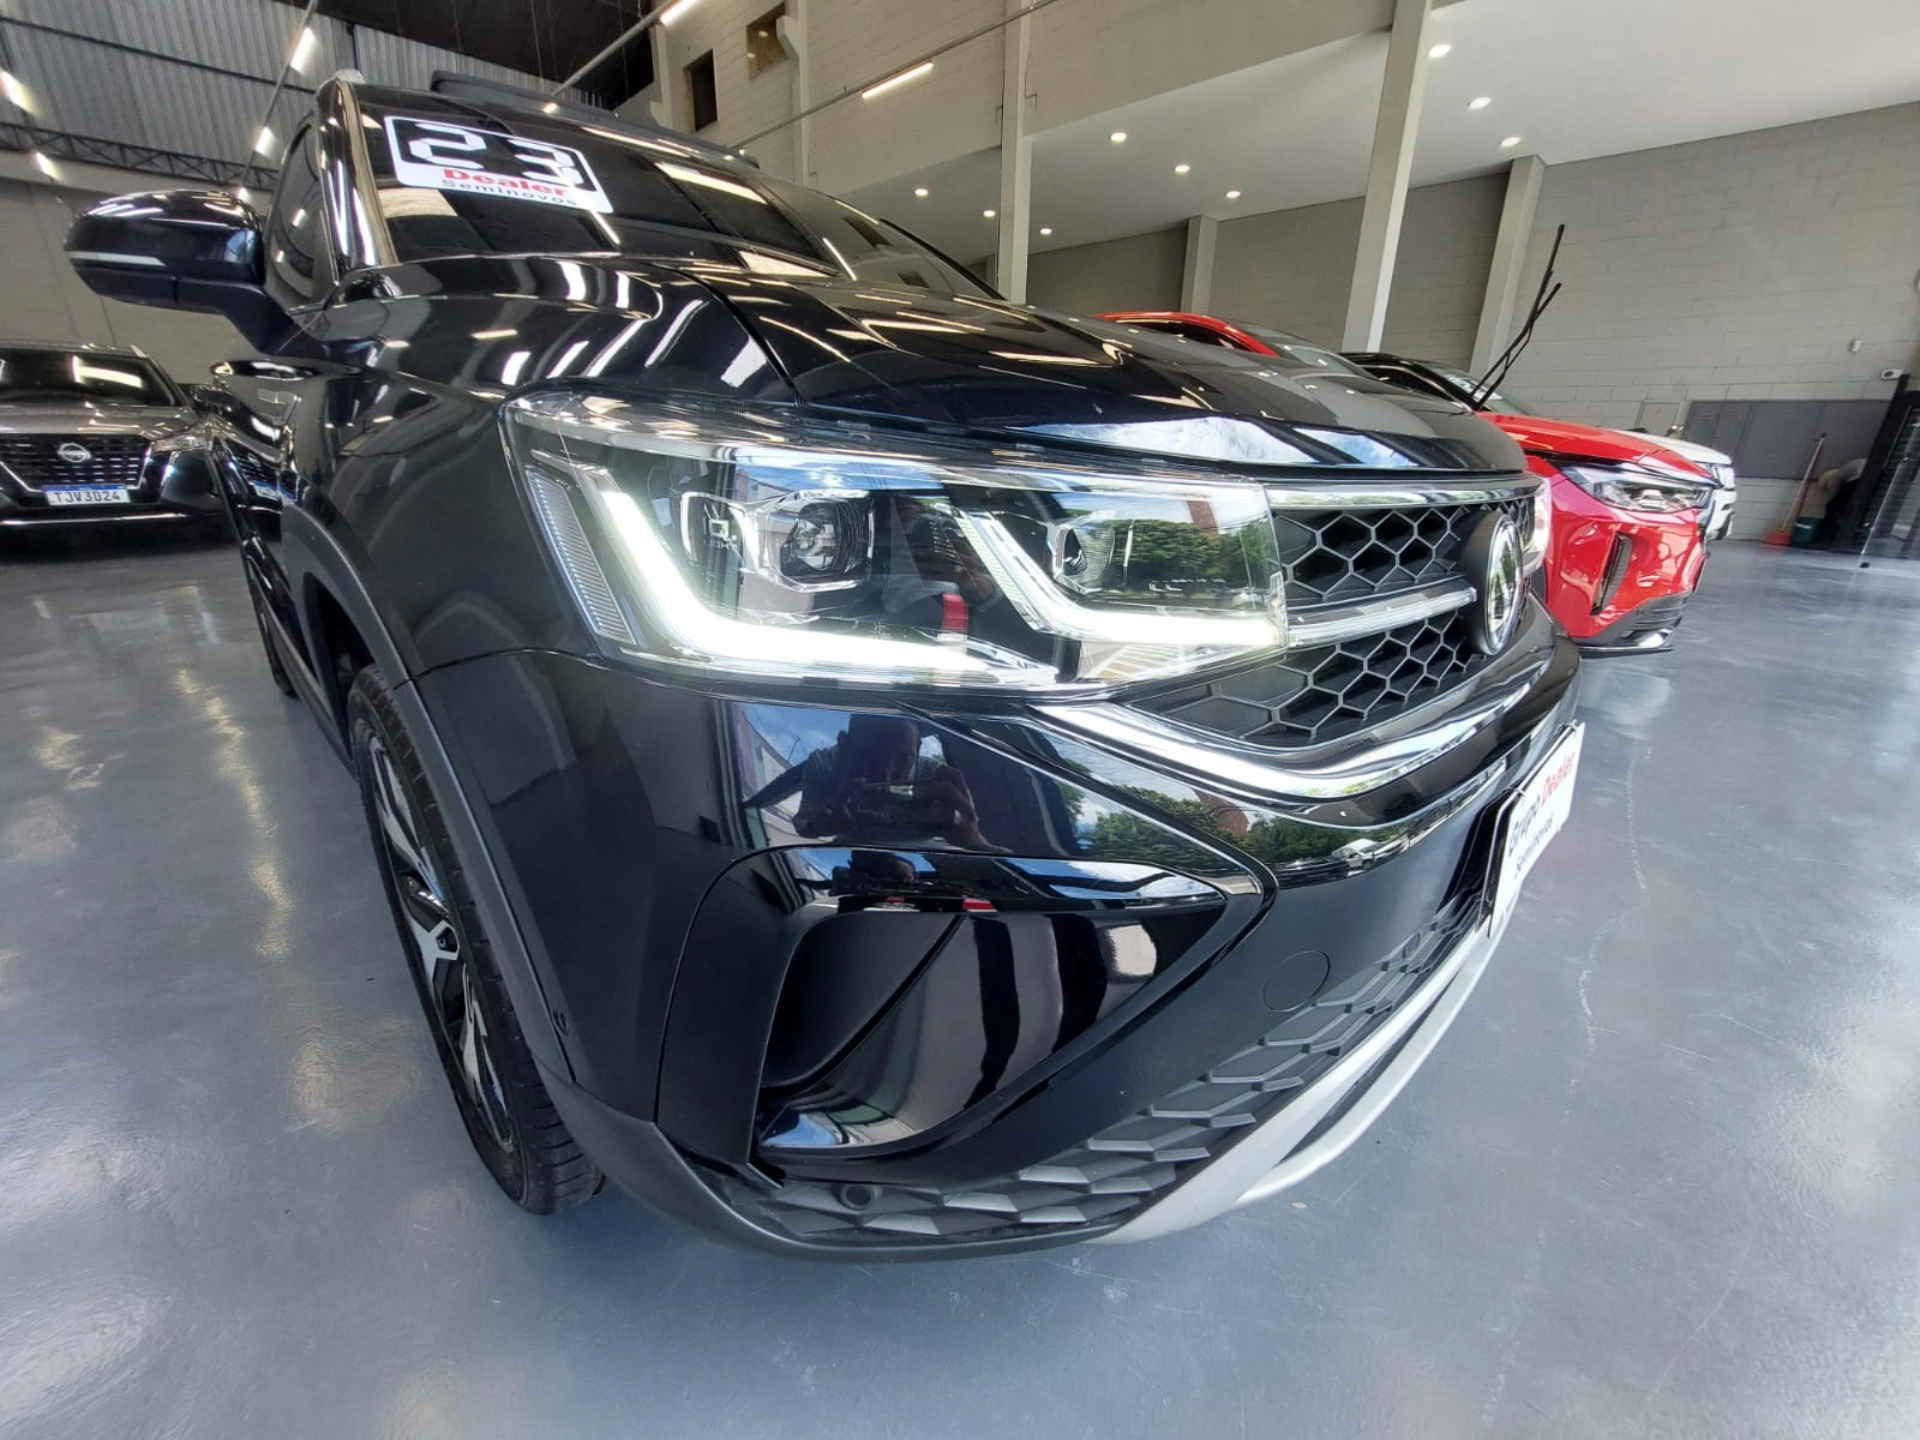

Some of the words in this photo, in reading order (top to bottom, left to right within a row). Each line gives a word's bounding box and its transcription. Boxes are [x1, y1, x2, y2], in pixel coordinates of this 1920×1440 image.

[408, 122, 584, 187] 23
[441, 179, 577, 206] Seminovos
[442, 168, 568, 197] Dealer
